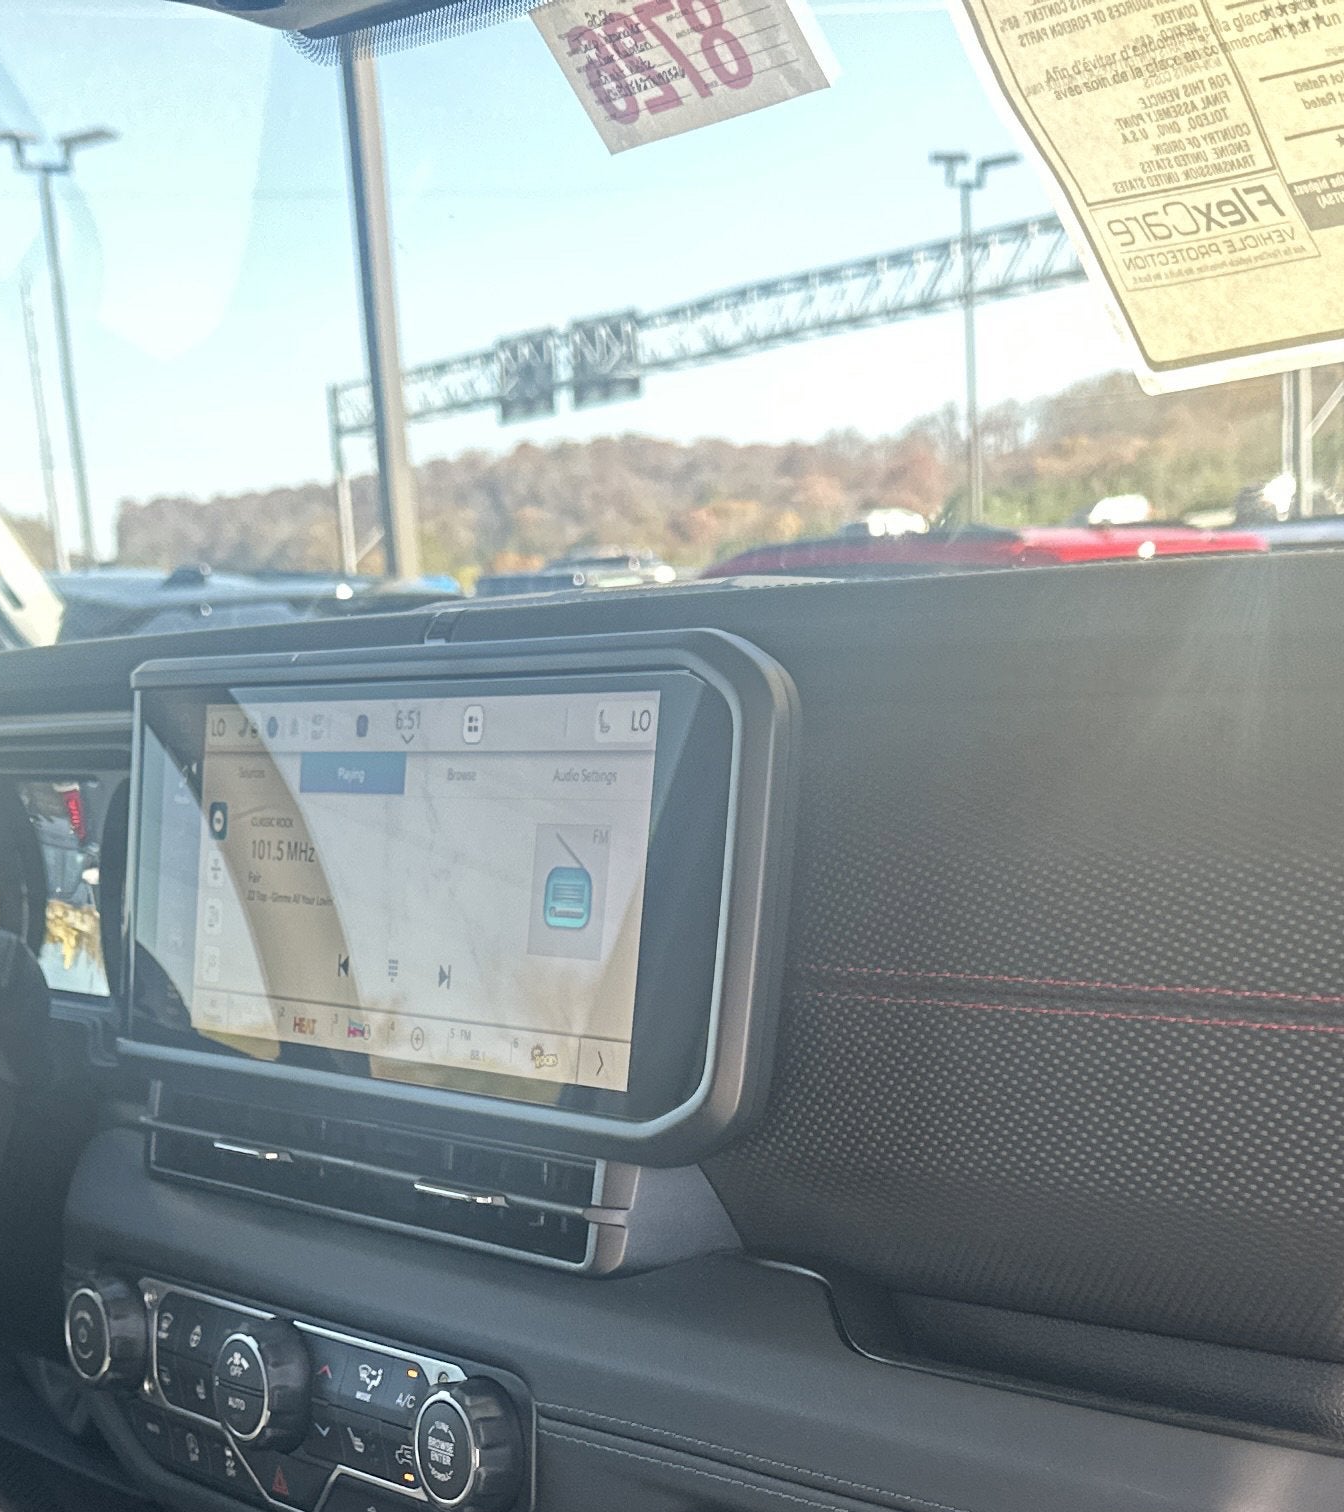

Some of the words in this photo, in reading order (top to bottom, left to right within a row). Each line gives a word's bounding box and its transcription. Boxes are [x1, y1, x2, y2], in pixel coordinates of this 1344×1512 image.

[211, 717, 226, 738] LO
[395, 709, 422, 731] 6:51
[630, 709, 652, 732] LO
[553, 768, 579, 783] Audio
[582, 768, 617, 785] Settings
[251, 839, 285, 862] 101.5
[286, 841, 316, 863] MHz
[292, 1016, 317, 1036] HEAT
[396, 1392, 416, 1408] A/C
